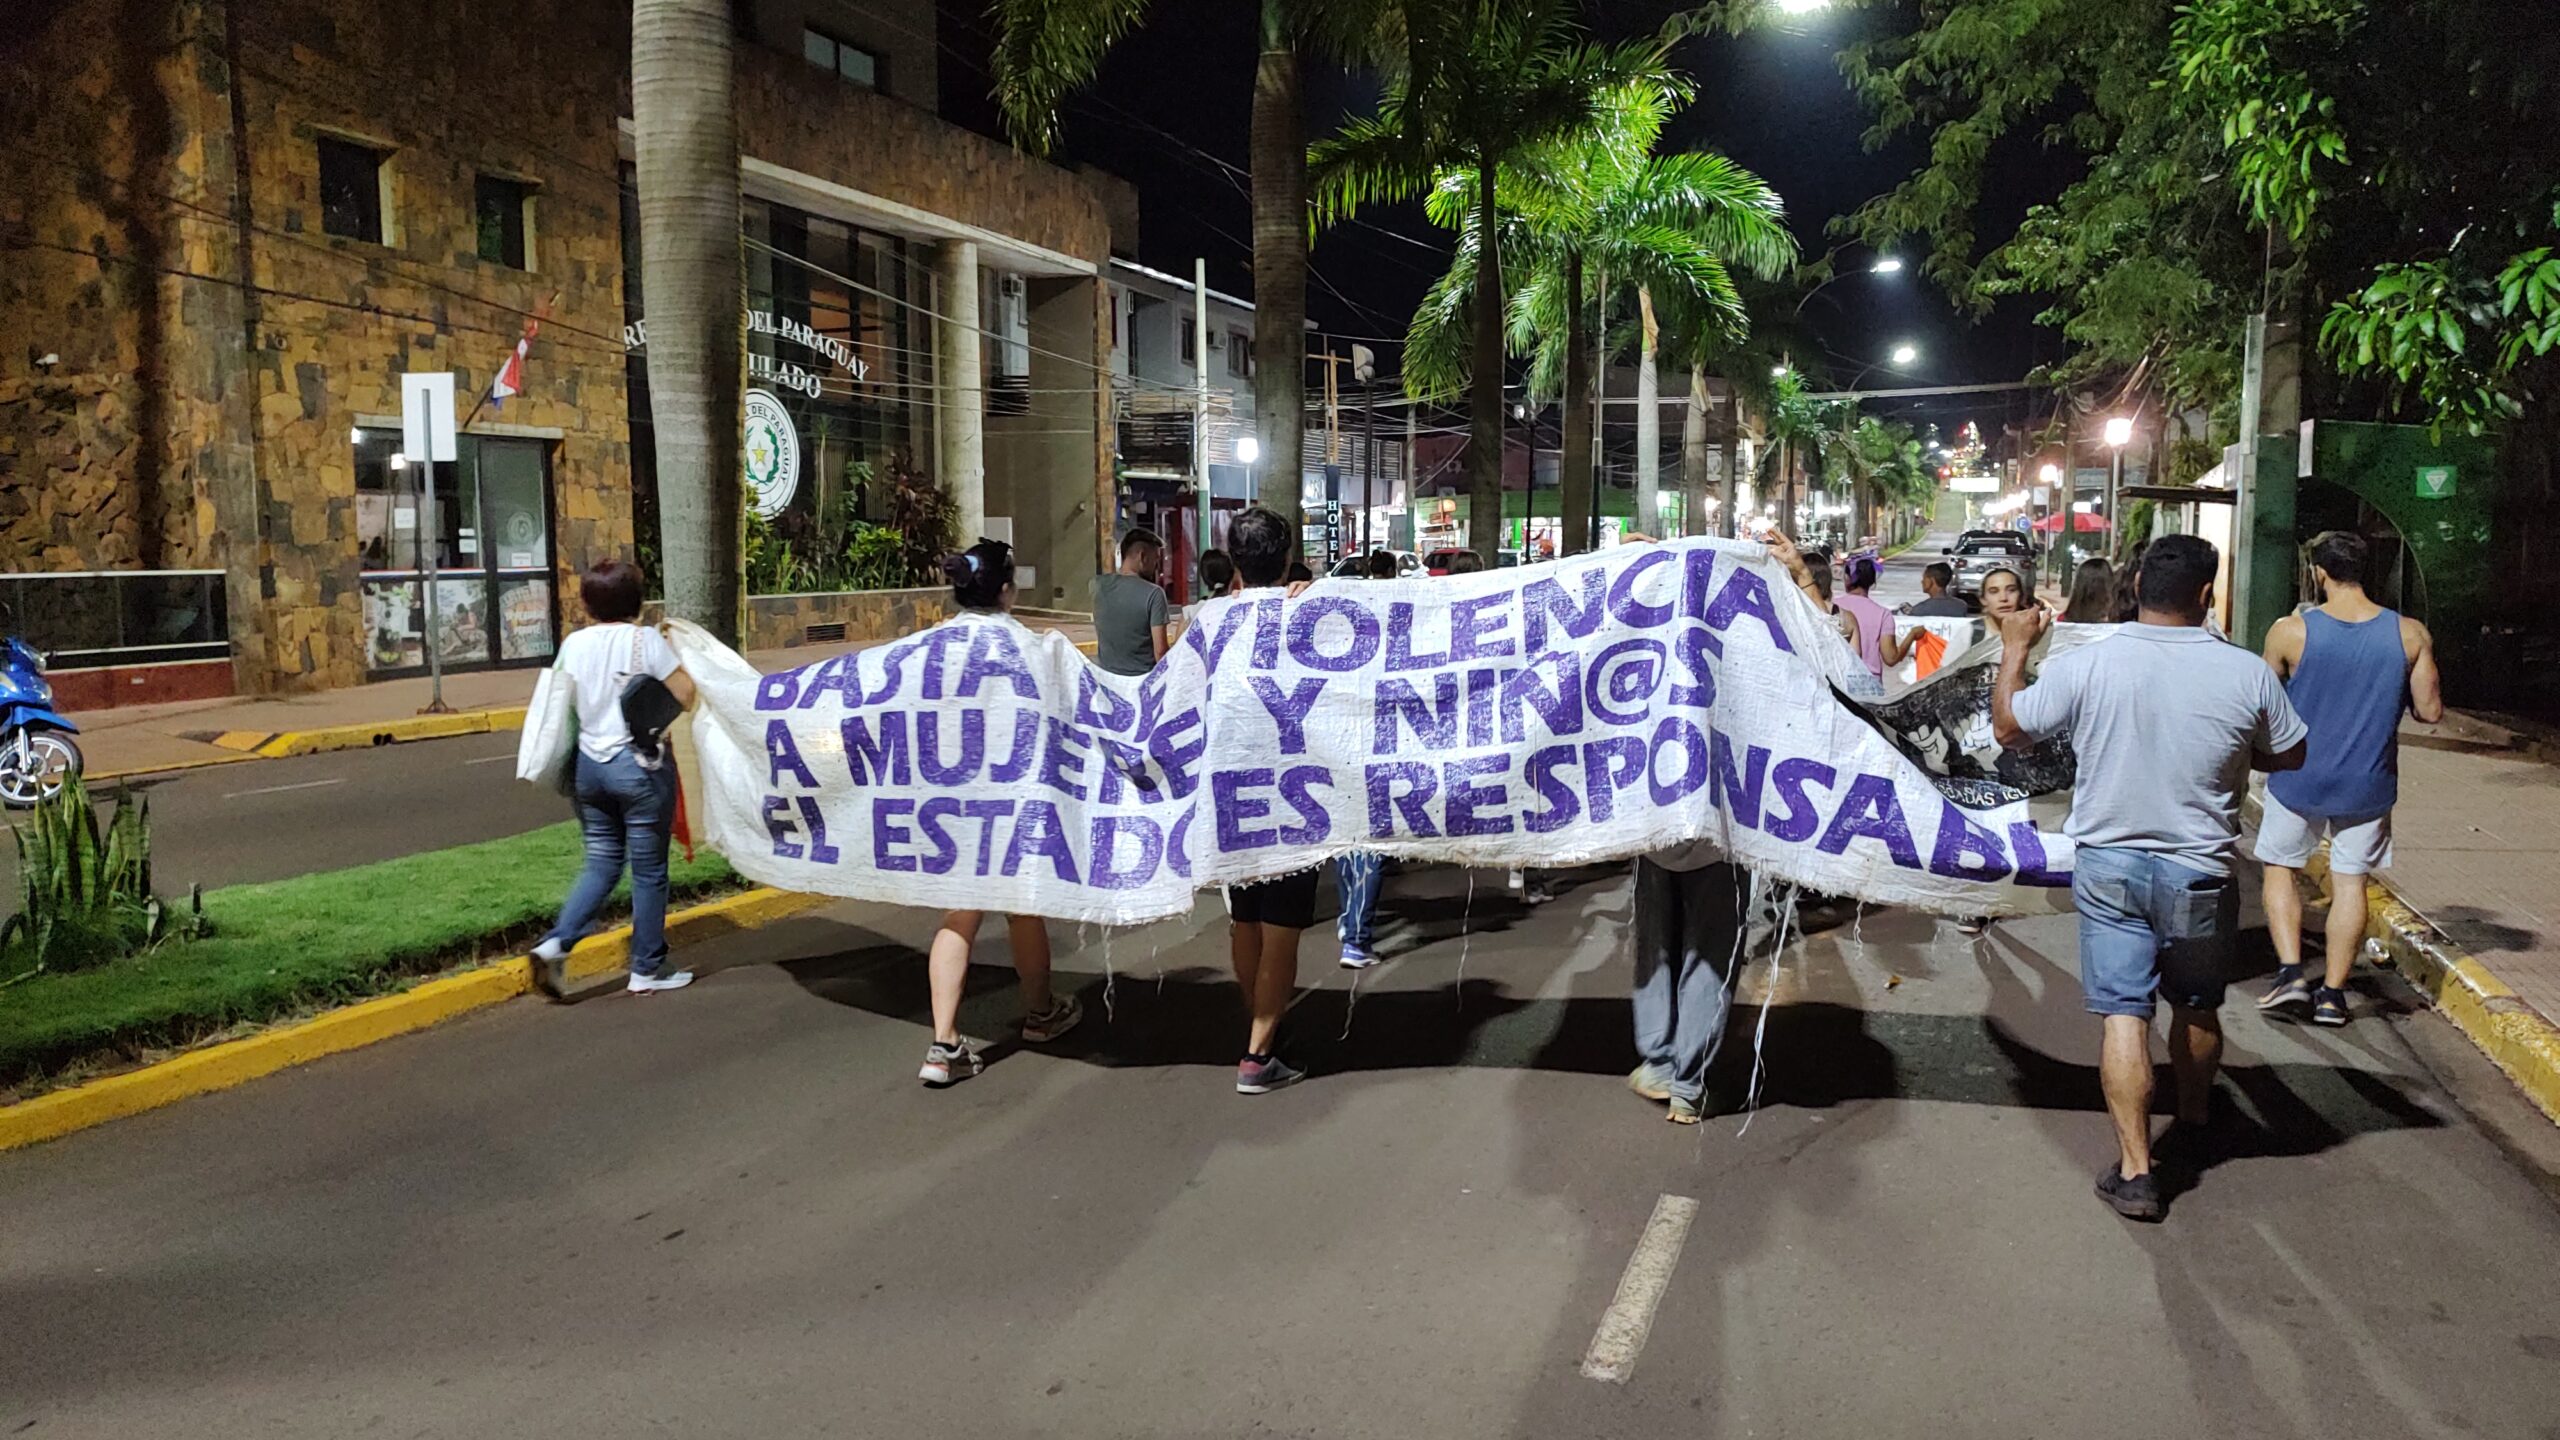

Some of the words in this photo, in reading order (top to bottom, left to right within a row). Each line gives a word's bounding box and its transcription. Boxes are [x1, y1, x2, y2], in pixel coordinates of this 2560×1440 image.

[781, 315, 870, 382] PARAGUAY
[751, 405, 768, 418] DEL
[770, 413, 791, 485] PARAGUAY
[1327, 500, 1338, 563] HOTEL
[754, 625, 1040, 711] BASTA
[1074, 657, 1169, 743] DE
[1186, 549, 1797, 679] VIOLENCIA
[766, 719, 821, 788] A
[840, 700, 1209, 805] MUJERE
[1247, 676, 1328, 755] Y
[762, 795, 839, 865] EL
[1211, 764, 1333, 853] ES
